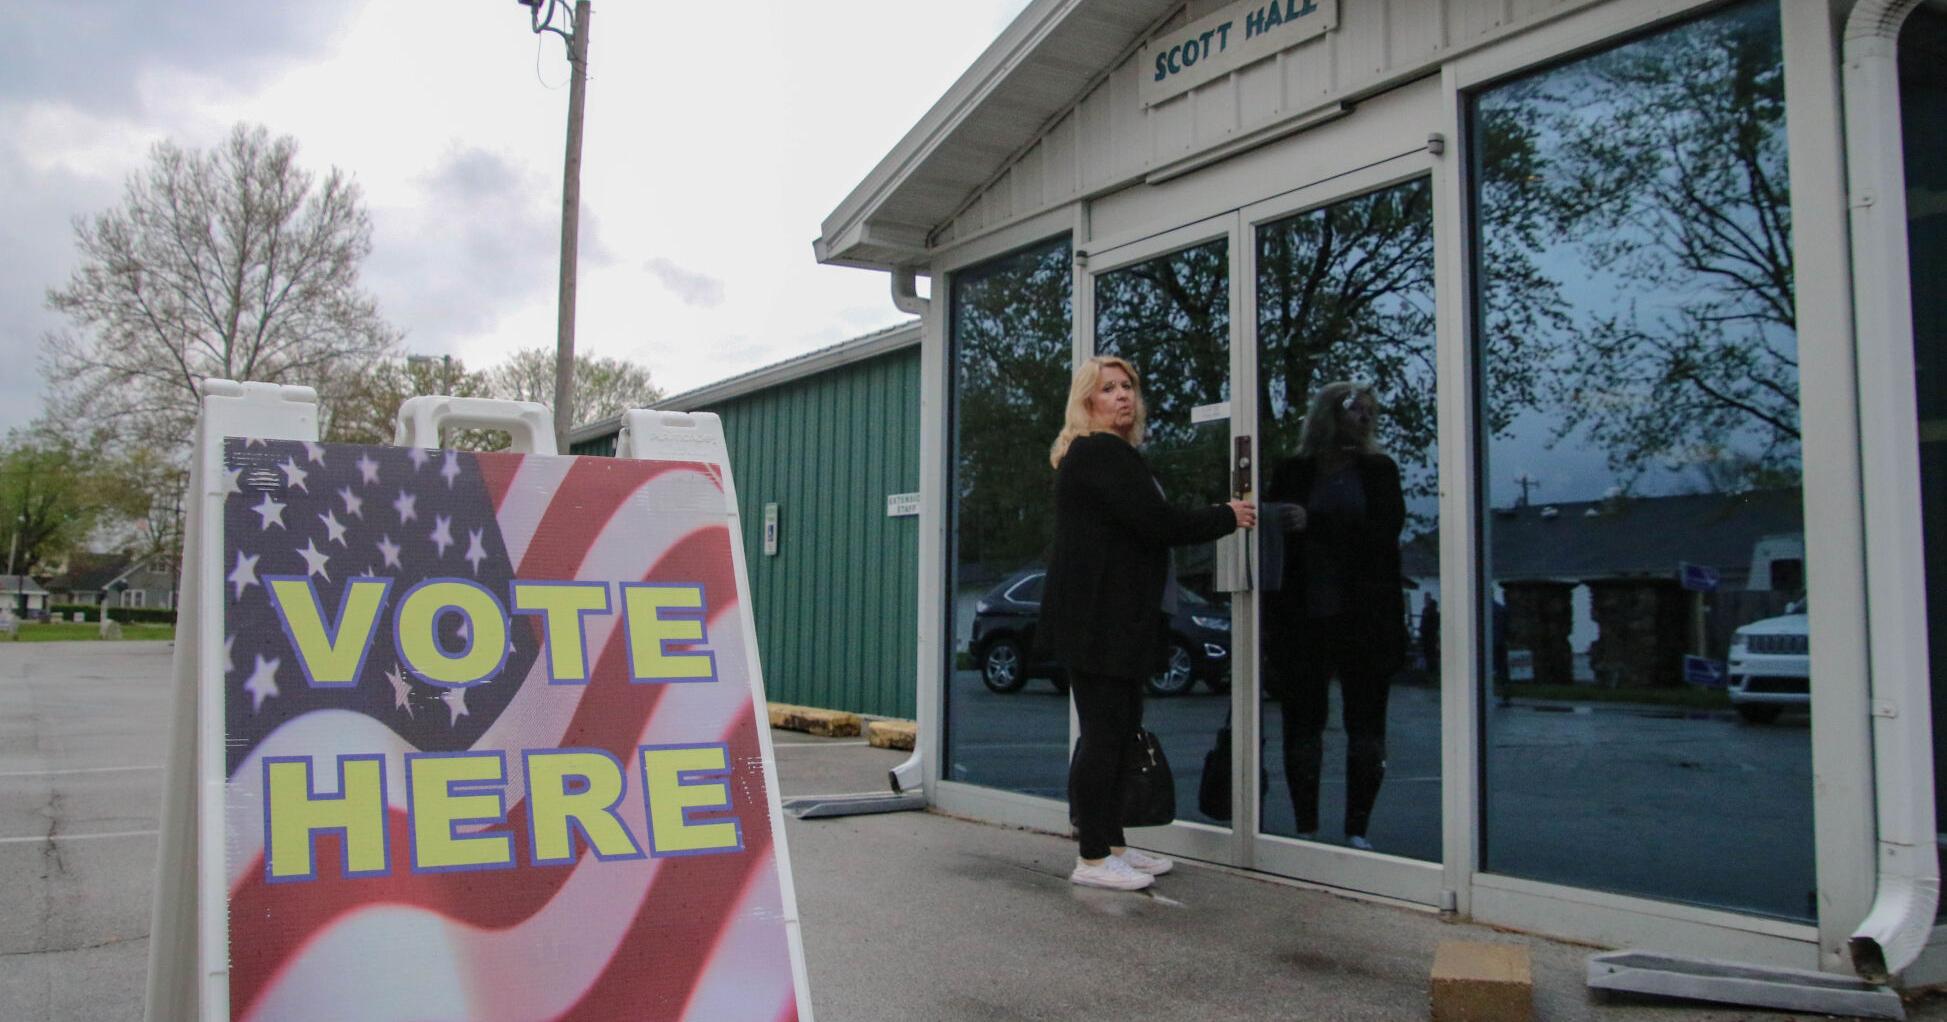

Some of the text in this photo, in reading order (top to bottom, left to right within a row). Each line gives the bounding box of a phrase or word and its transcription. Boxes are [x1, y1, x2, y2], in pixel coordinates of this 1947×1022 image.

[1154, 0, 1318, 82] SCOTT HALL
[262, 575, 719, 689] VOTE
[262, 742, 745, 885] HERE
